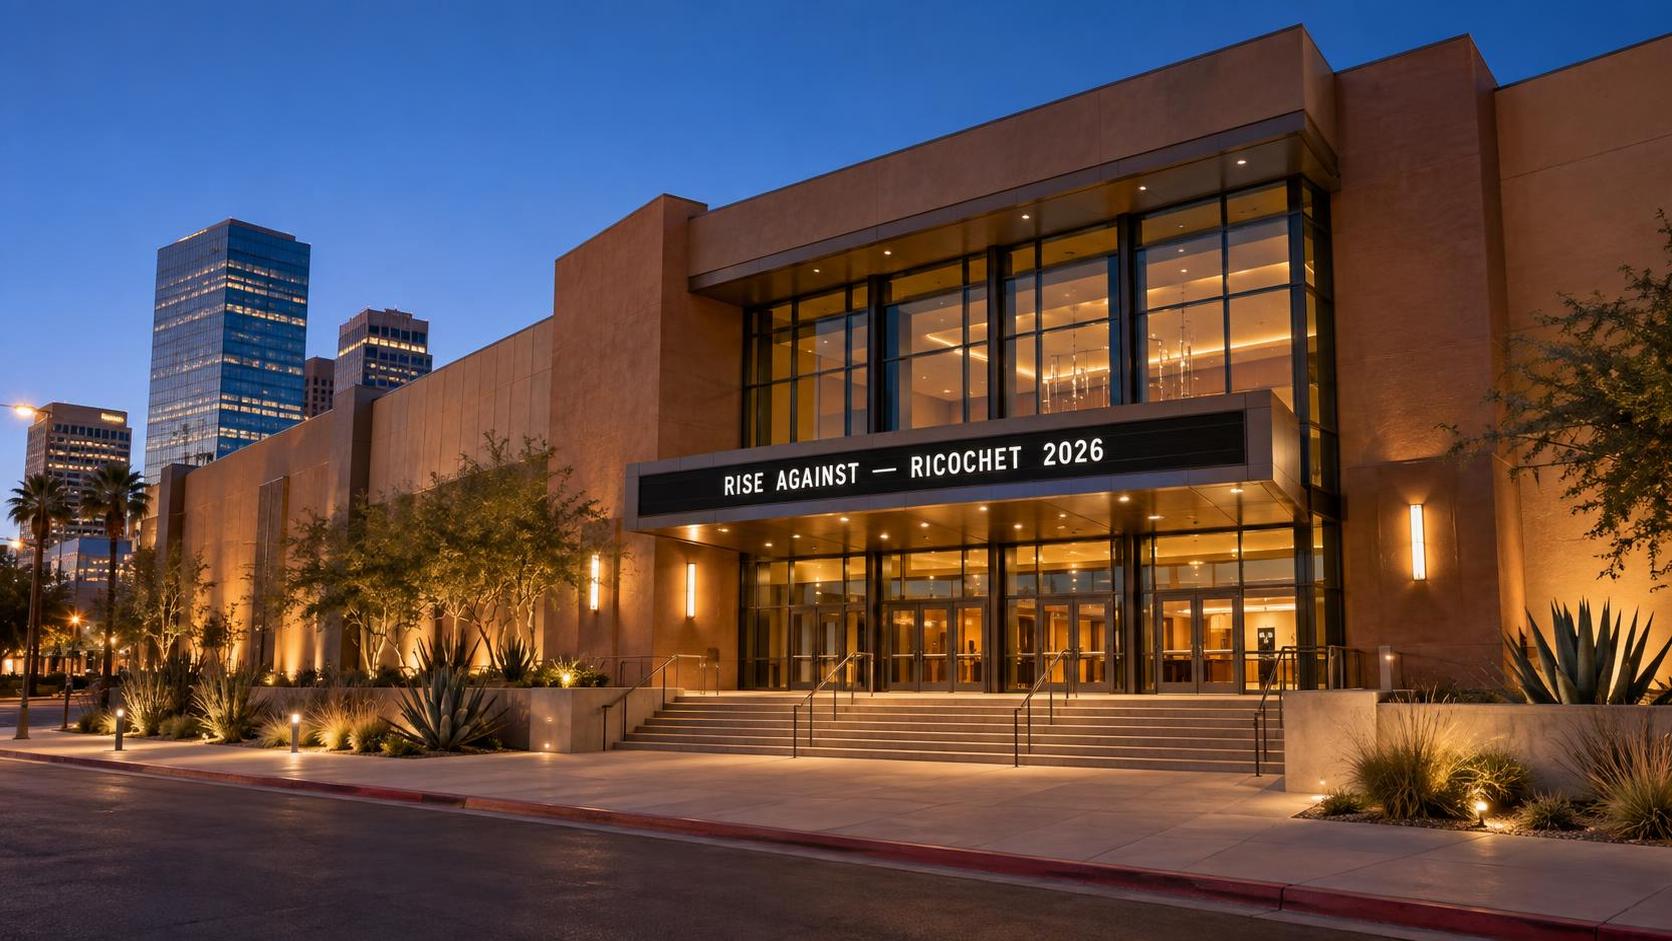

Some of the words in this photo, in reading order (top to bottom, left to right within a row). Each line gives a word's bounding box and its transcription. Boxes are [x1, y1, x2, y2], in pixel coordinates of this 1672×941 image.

[724, 472, 764, 496] RISE
[775, 462, 860, 491] AGAINST
[910, 445, 1022, 479] RICOCHET
[1043, 437, 1104, 466] 2026
